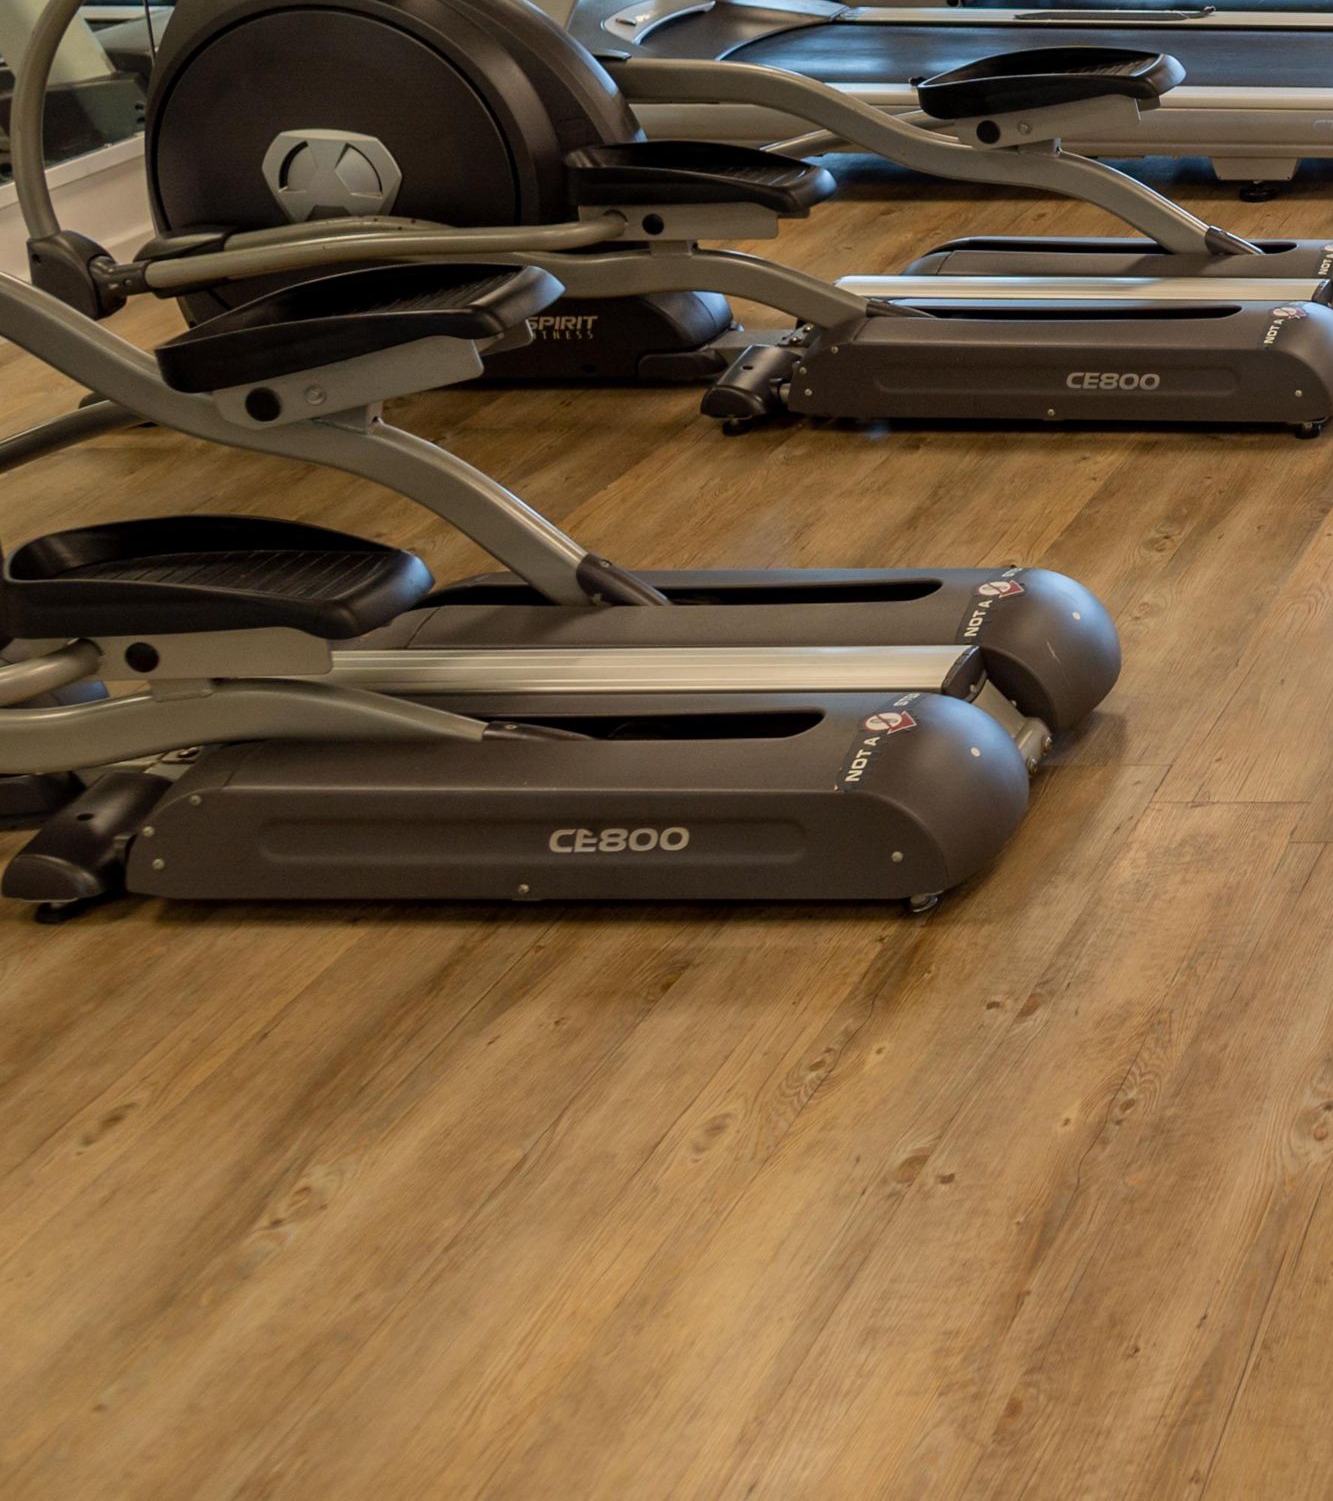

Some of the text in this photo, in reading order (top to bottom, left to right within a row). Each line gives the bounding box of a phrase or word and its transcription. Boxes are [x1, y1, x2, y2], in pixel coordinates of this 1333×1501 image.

[1318, 259, 1332, 275] NOT
[528, 316, 598, 330] SPIRIT
[1263, 325, 1281, 344] NOT
[1066, 372, 1160, 390] CE800
[964, 600, 993, 637] NOT A
[845, 736, 880, 782] NOT A
[548, 826, 690, 853] CE800
